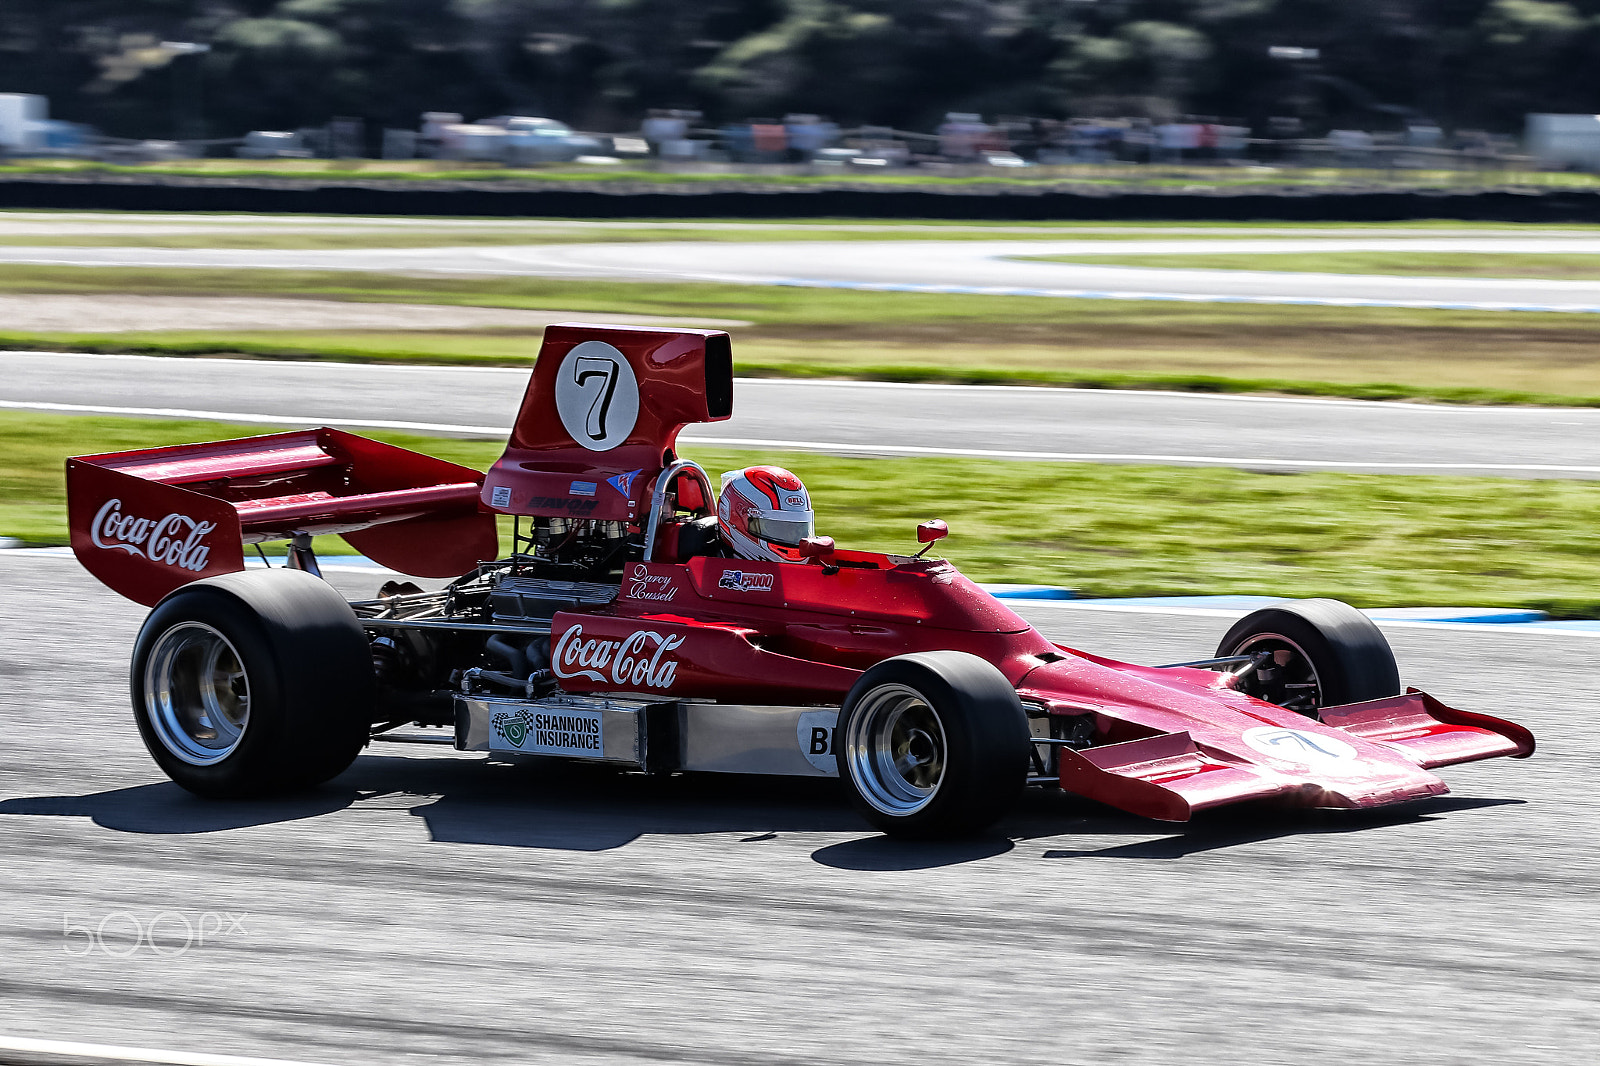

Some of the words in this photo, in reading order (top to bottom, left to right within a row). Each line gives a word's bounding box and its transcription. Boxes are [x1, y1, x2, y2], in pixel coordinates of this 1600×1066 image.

[574, 357, 620, 441] 7
[541, 497, 600, 511] AVON
[91, 499, 218, 572] Coca-Cola
[629, 564, 672, 591] Darcy
[742, 575, 772, 587] F5000
[626, 581, 678, 601] Russell
[552, 624, 687, 689] Coca-Cola
[535, 714, 599, 734] SHANNONS
[536, 730, 600, 750] INSURANCE
